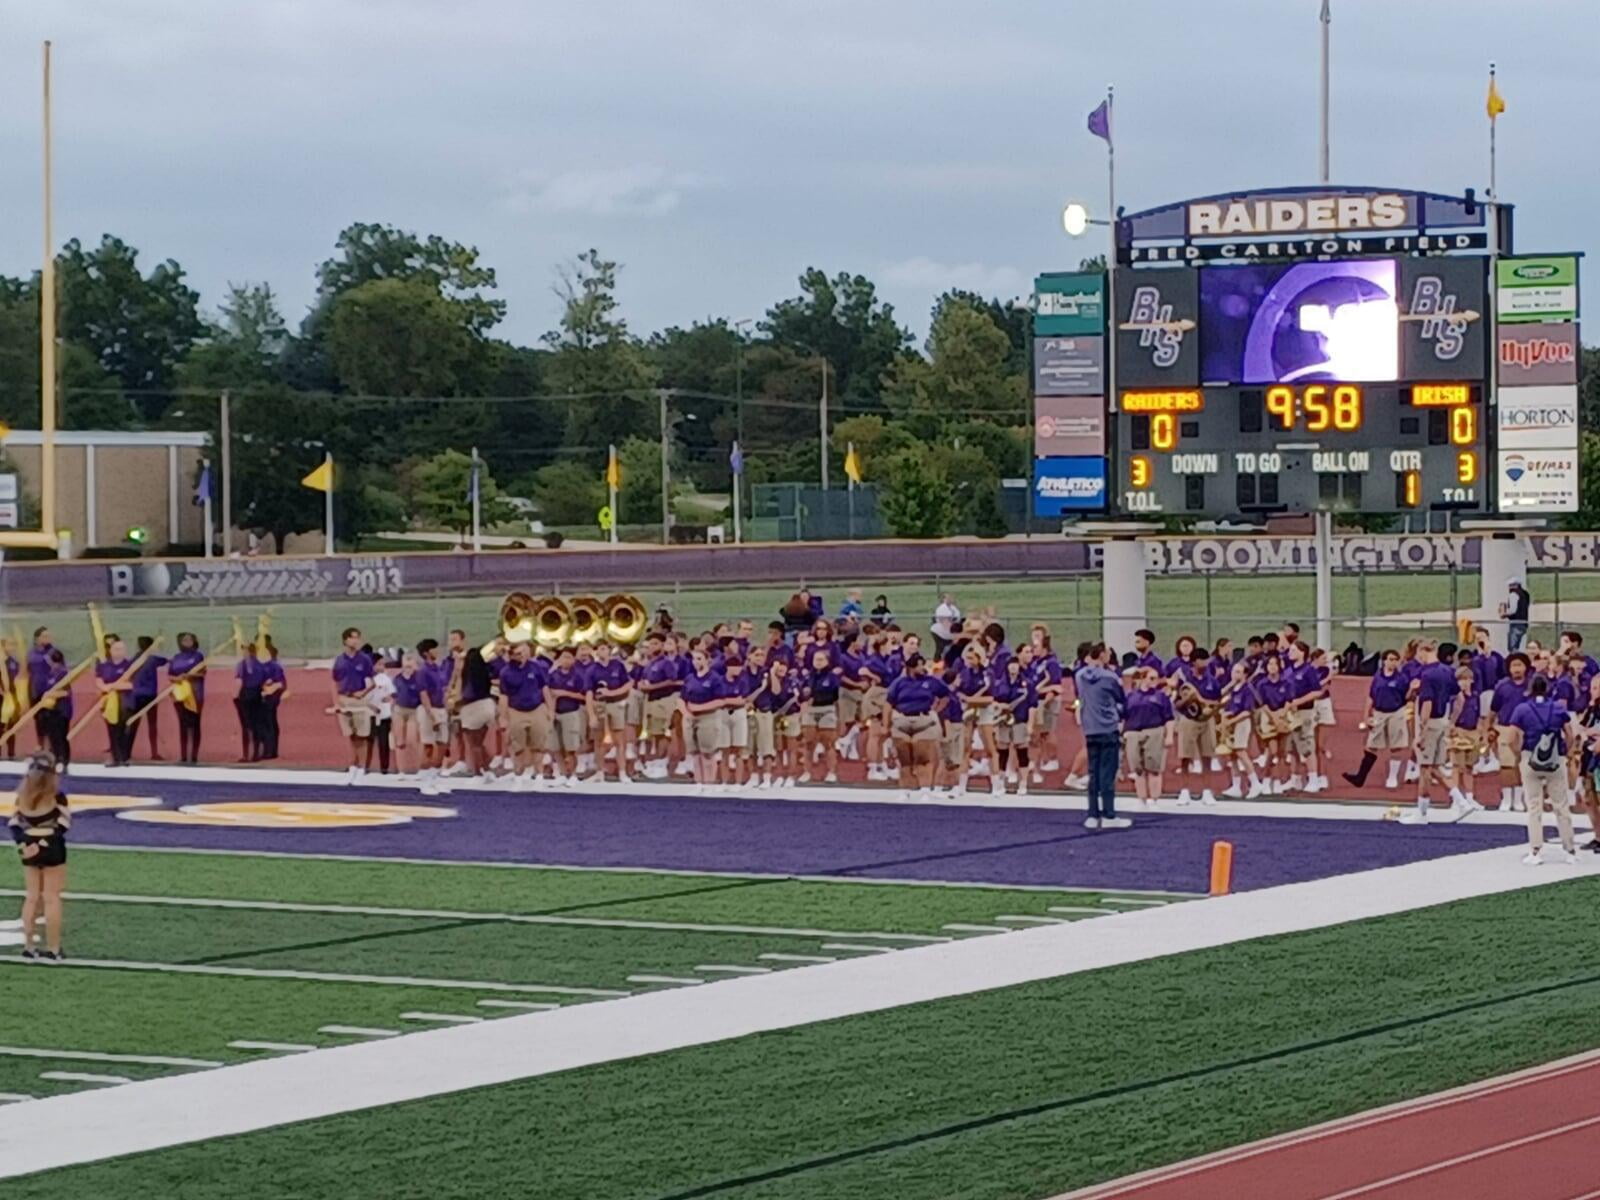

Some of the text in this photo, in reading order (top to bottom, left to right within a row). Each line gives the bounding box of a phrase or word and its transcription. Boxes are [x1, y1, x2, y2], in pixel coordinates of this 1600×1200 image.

[1189, 194, 1407, 236] RAIDERS
[1221, 240, 1363, 257] CARLTON
[1385, 234, 1471, 251] FIELD
[1122, 392, 1202, 410] RAIDERS
[1411, 384, 1470, 406] IRISH
[1265, 385, 1361, 431] 9:58
[1501, 408, 1575, 425] HORTON
[1151, 412, 1174, 449] 0
[1451, 406, 1476, 445] 0
[1130, 457, 1149, 487] 3
[1171, 453, 1218, 474] DOWN
[1235, 453, 1281, 473] TO GO
[1312, 452, 1369, 472] BALL ON
[1390, 451, 1421, 470] QTR
[1457, 452, 1476, 483] 3
[1405, 473, 1419, 506] 1
[347, 567, 401, 595] 2013
